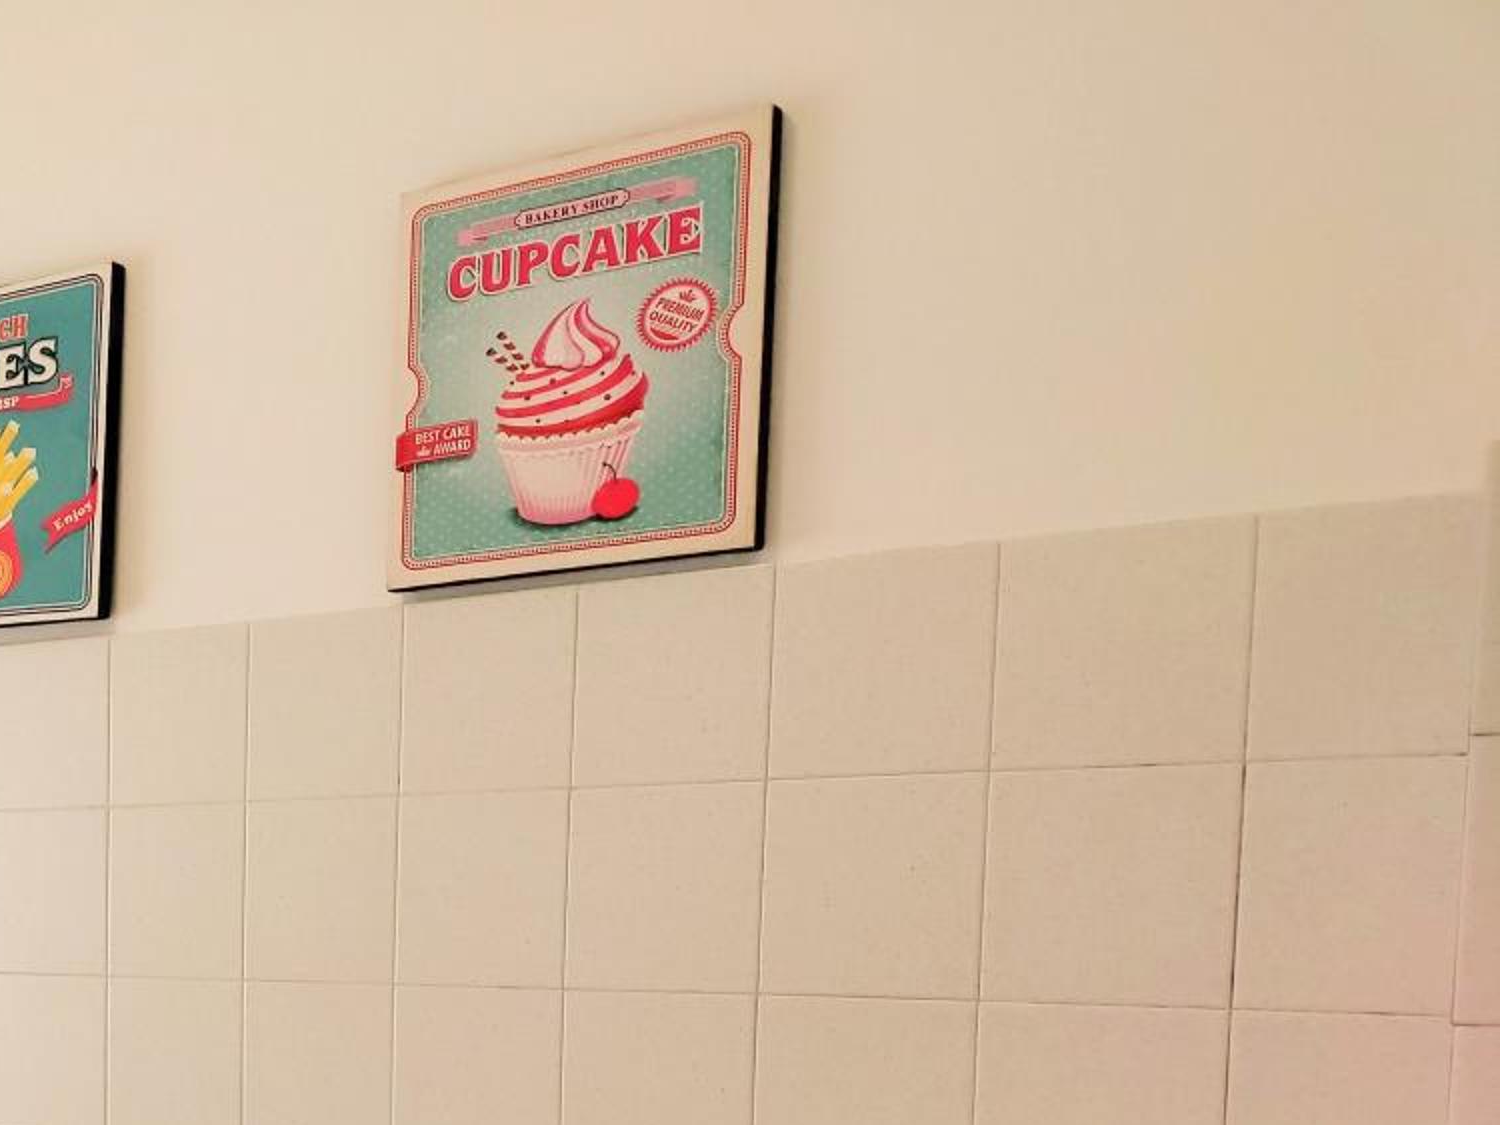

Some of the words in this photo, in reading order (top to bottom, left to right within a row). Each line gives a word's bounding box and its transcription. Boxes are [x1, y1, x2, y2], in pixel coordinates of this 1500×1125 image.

[524, 204, 580, 225] BAKERY
[582, 194, 620, 213] SHOP
[448, 203, 704, 301] CUPCAKE
[655, 297, 706, 321] PREMIUM
[649, 310, 699, 333] QUALITY
[415, 429, 440, 445] BEST
[443, 424, 471, 441] CAKE
[433, 438, 471, 455] AWARD
[52, 500, 92, 531] Enjoy
